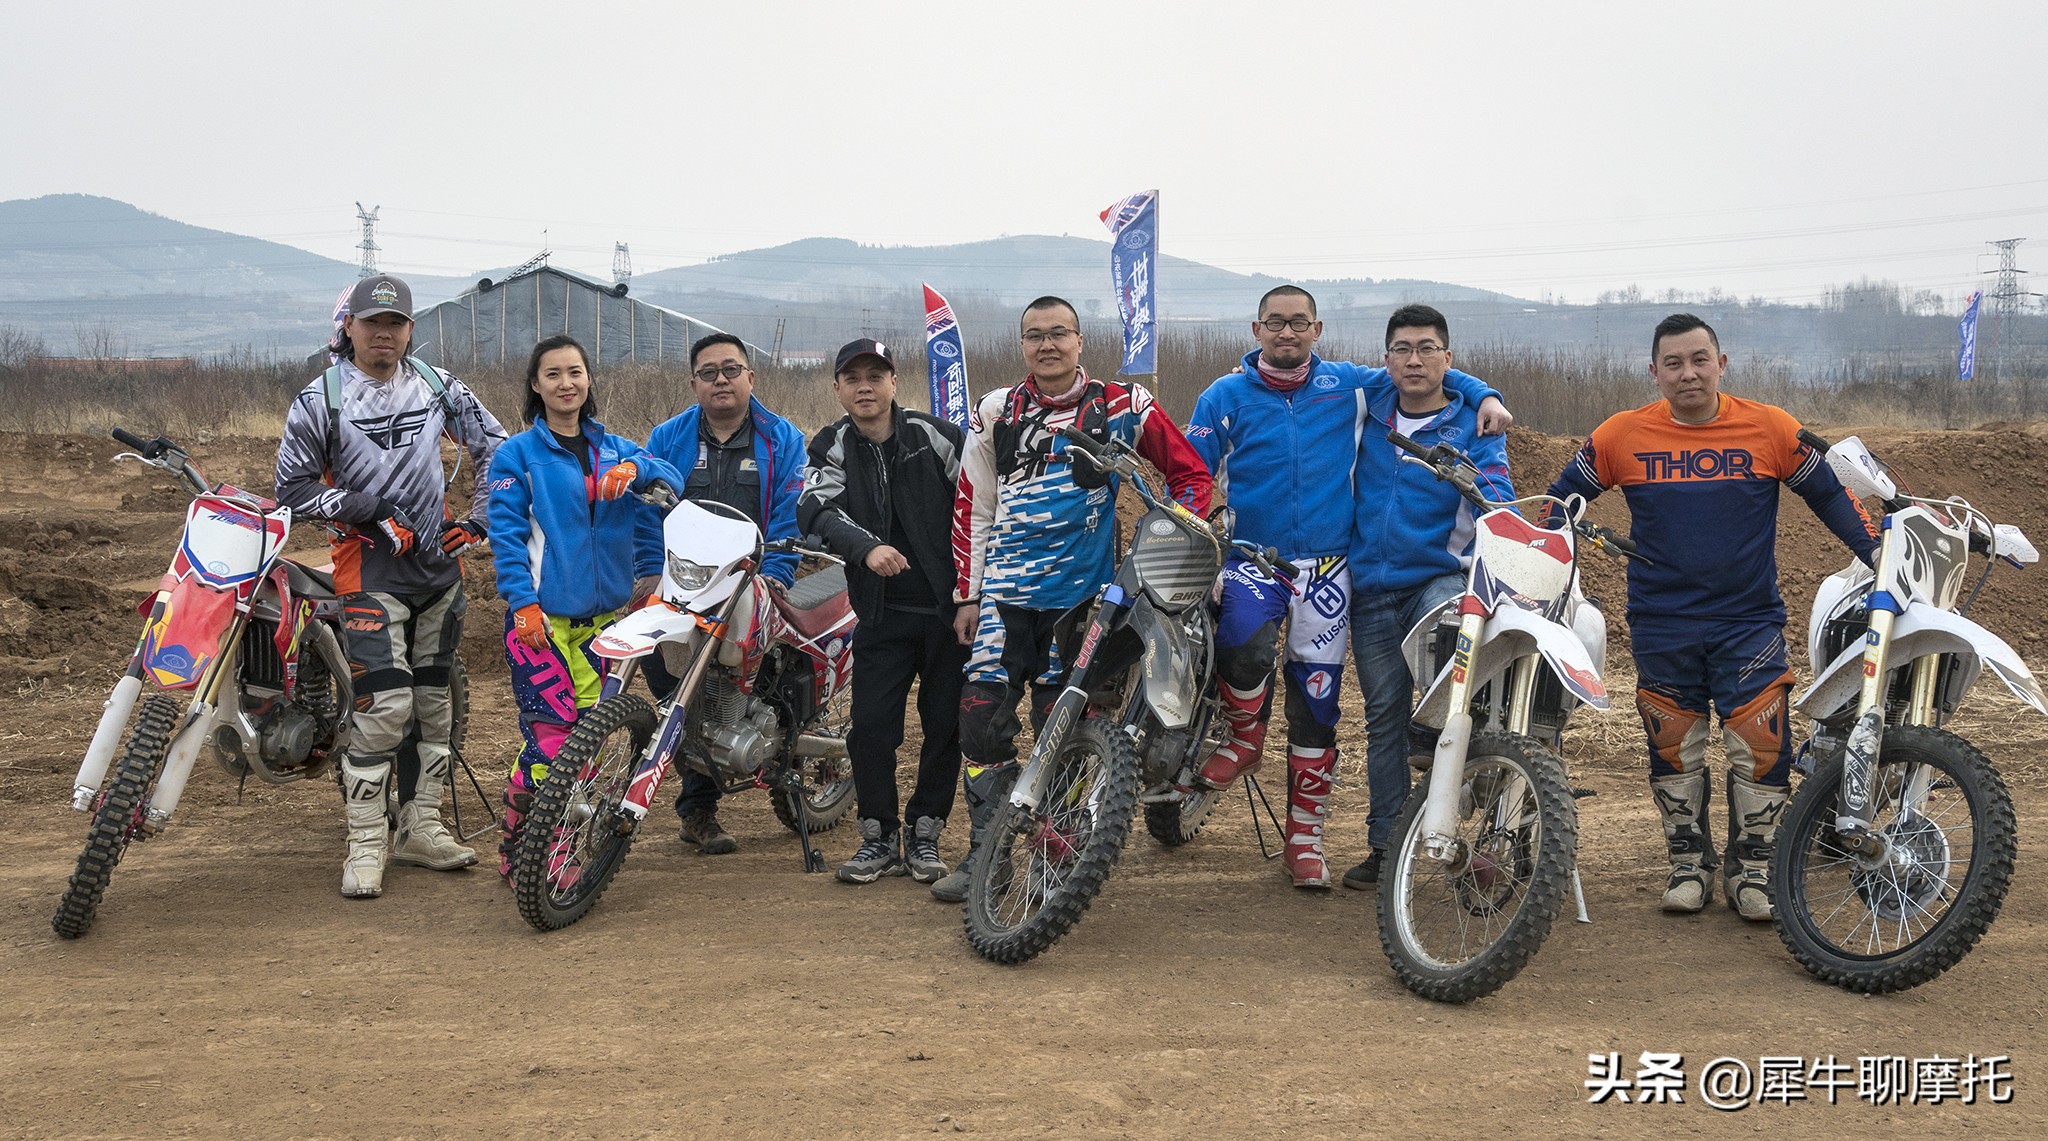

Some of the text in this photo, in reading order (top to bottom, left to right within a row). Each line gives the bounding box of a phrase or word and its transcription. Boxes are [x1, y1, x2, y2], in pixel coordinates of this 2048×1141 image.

[1634, 448, 1758, 480] THOR
[1169, 591, 1205, 602] BHR
[345, 617, 383, 632] KTM
[1453, 629, 1474, 684] BHR
[1863, 626, 1881, 682] BHR
[1756, 696, 1782, 727] thor
